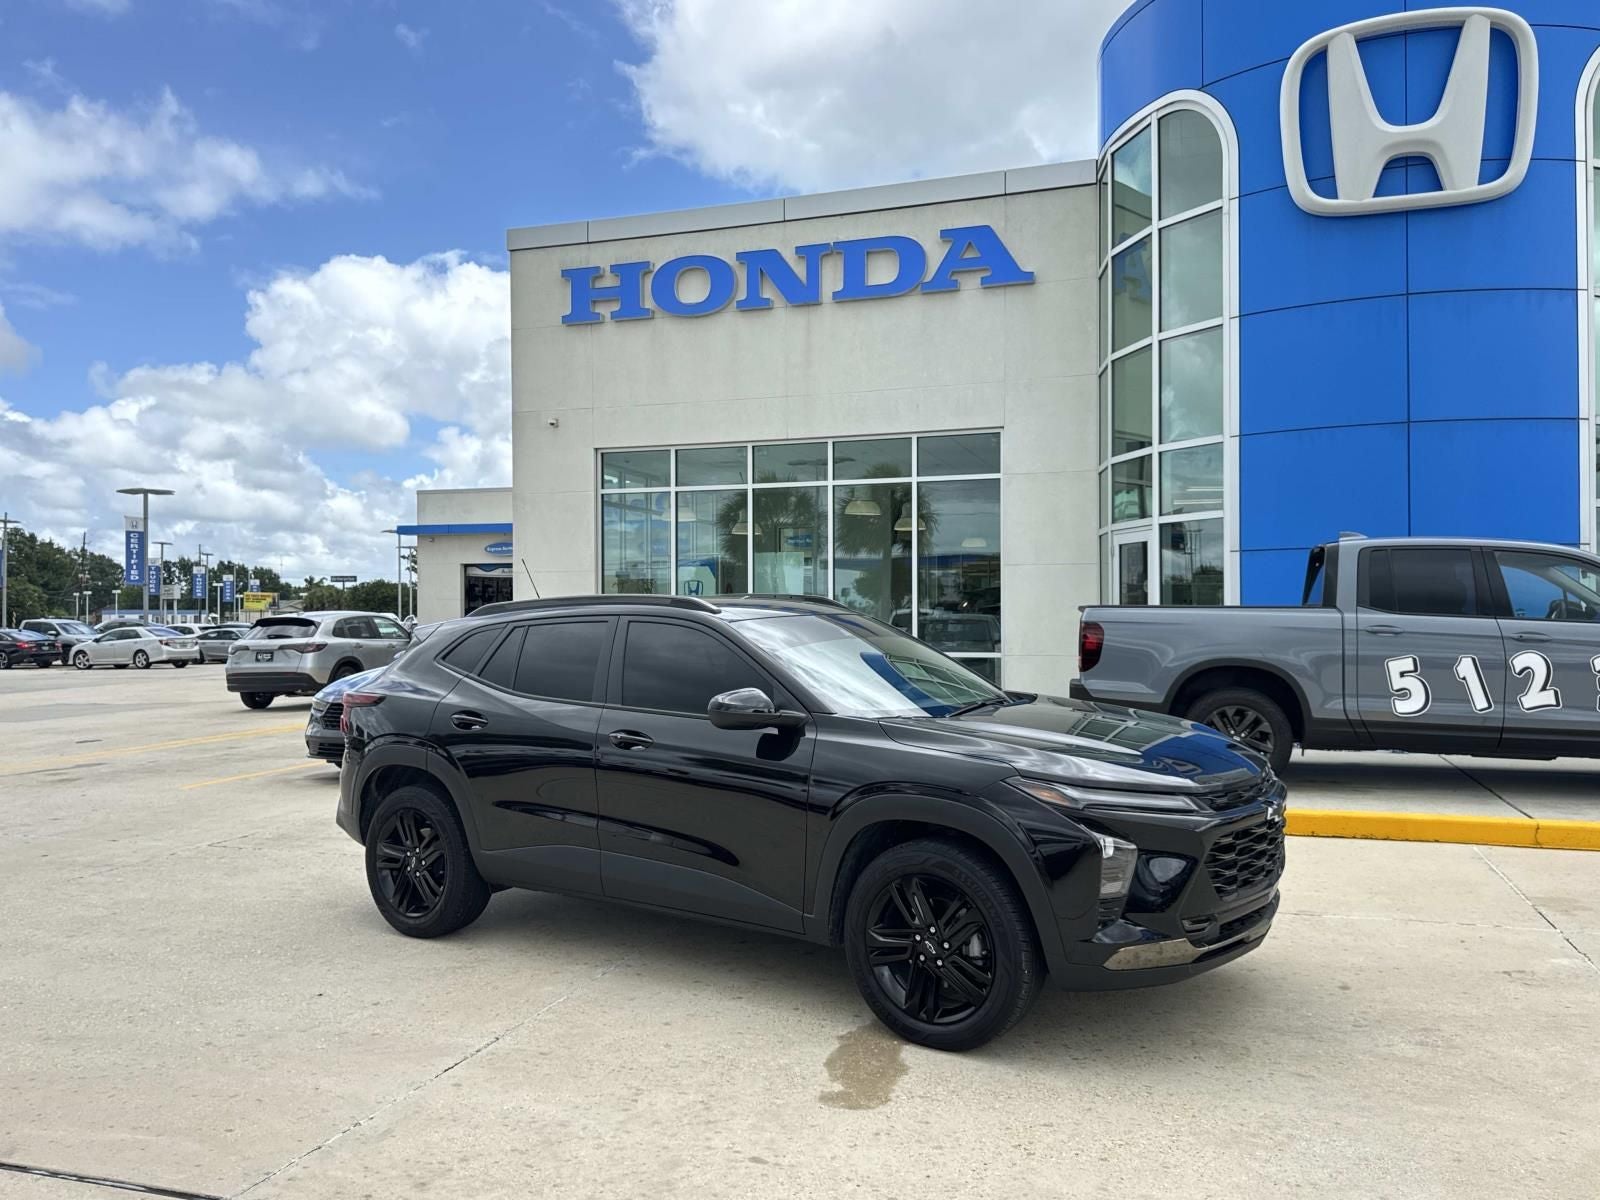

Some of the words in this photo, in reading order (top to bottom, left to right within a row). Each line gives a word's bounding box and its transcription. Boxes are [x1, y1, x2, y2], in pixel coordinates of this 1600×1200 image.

[560, 224, 1035, 326] HONDA
[130, 533, 140, 580] CERTIFIED
[1384, 650, 1600, 717] 512
